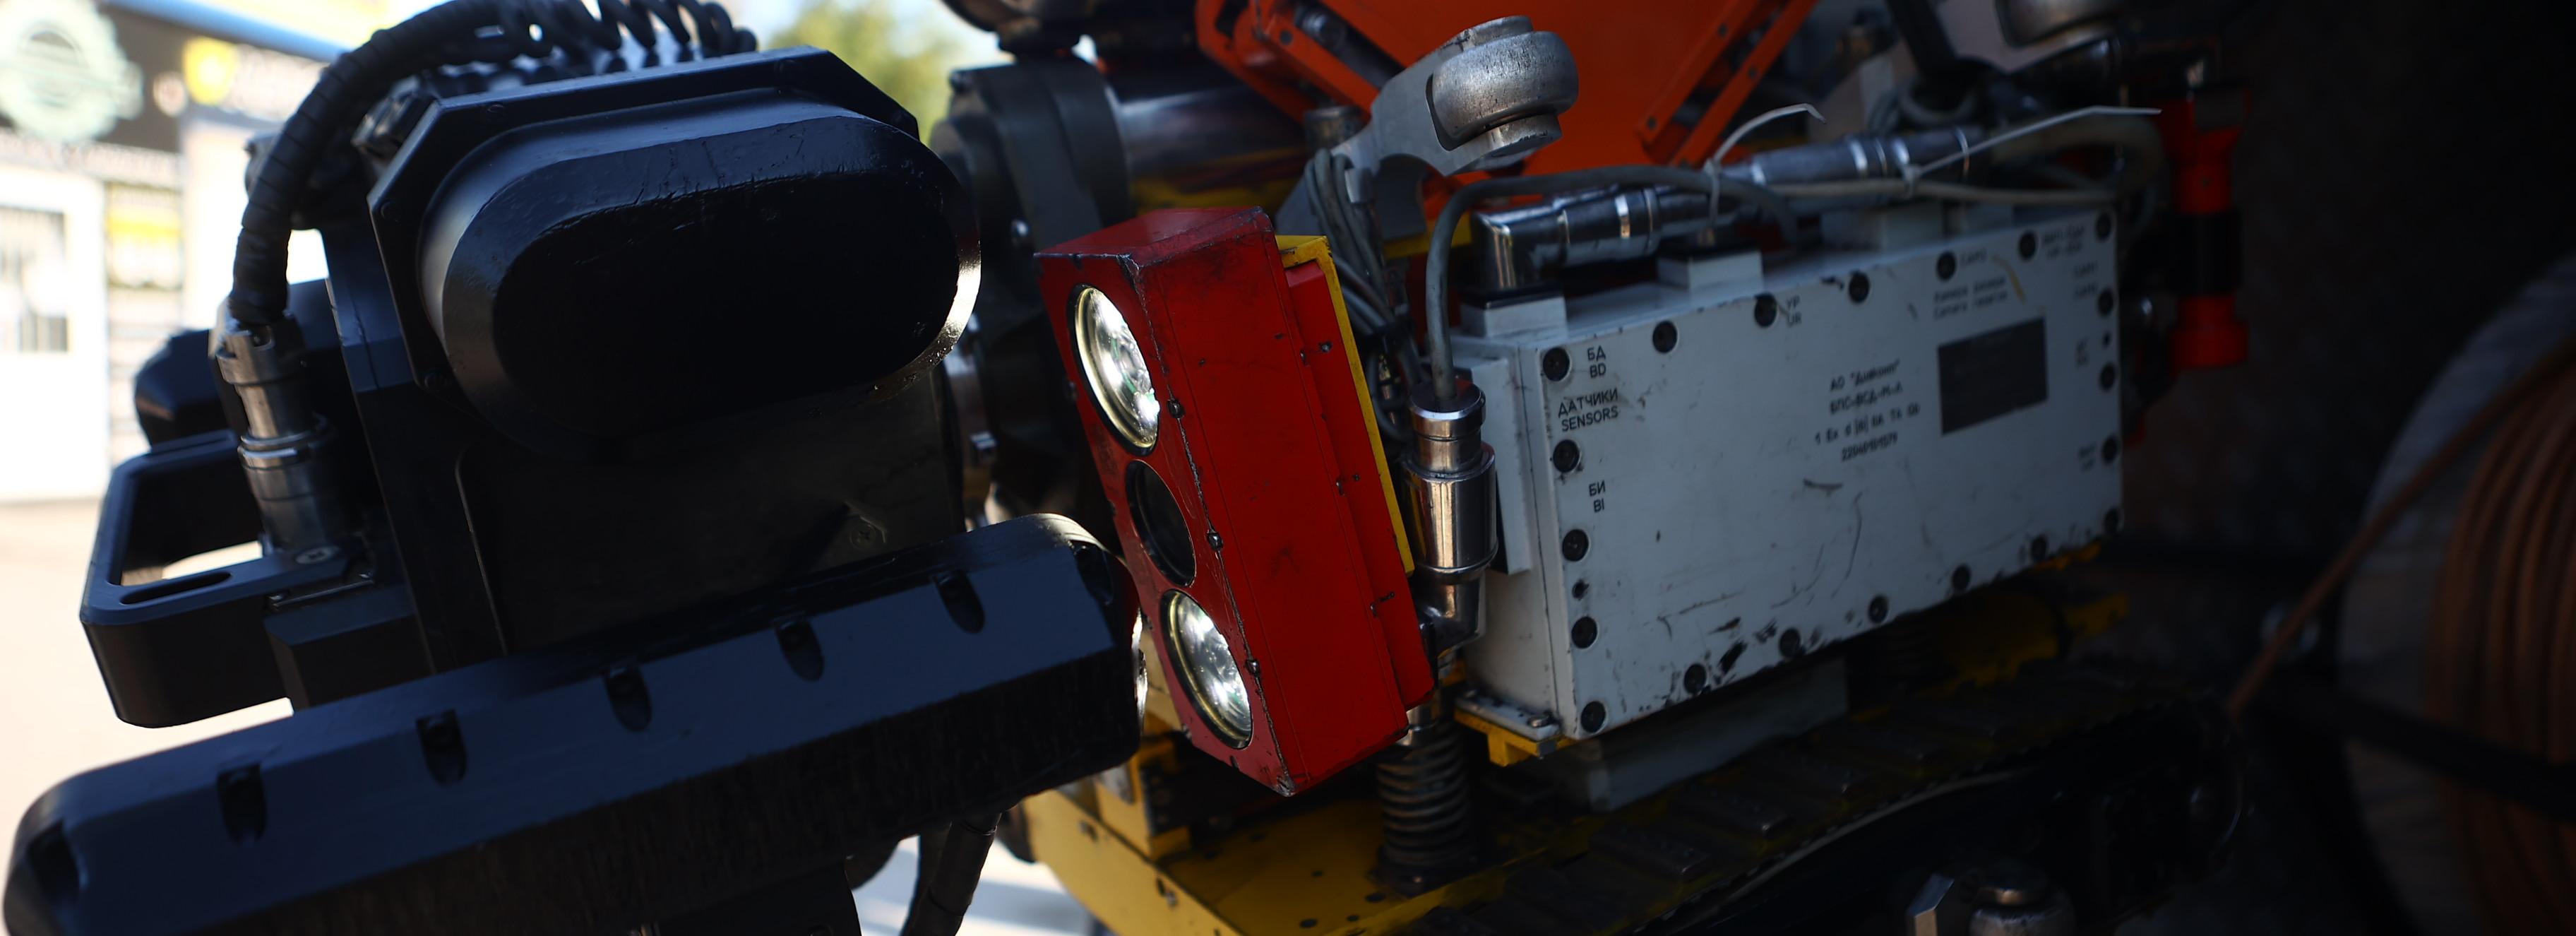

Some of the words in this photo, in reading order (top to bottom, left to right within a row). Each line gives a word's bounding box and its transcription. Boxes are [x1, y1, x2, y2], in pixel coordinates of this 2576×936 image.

[1590, 363, 1606, 378] BD
[1558, 388, 1618, 417] ДАТЧИКИ
[1561, 405, 1618, 432] SENSORS
[1589, 480, 1606, 497] БИ
[1593, 498, 1605, 513] BI
